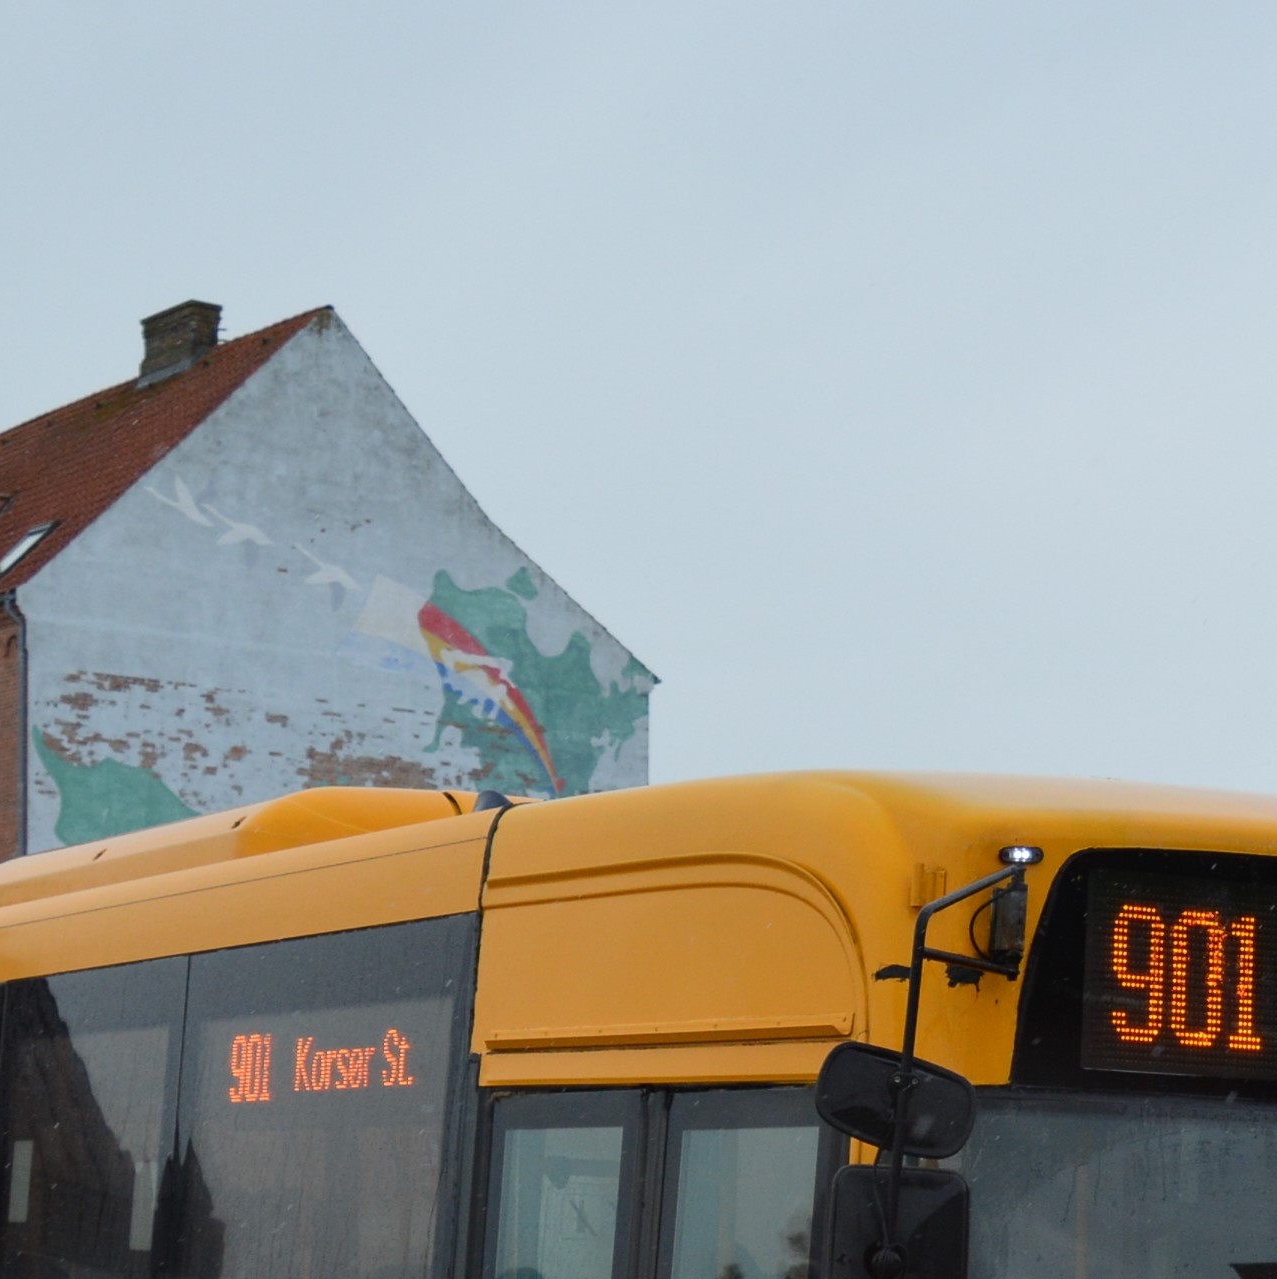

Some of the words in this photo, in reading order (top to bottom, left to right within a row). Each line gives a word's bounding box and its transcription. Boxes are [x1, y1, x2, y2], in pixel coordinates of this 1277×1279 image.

[1111, 904, 1262, 1051] 901
[229, 1034, 271, 1102] 901
[293, 1036, 376, 1092] Korsør
[381, 1028, 414, 1087] St.
